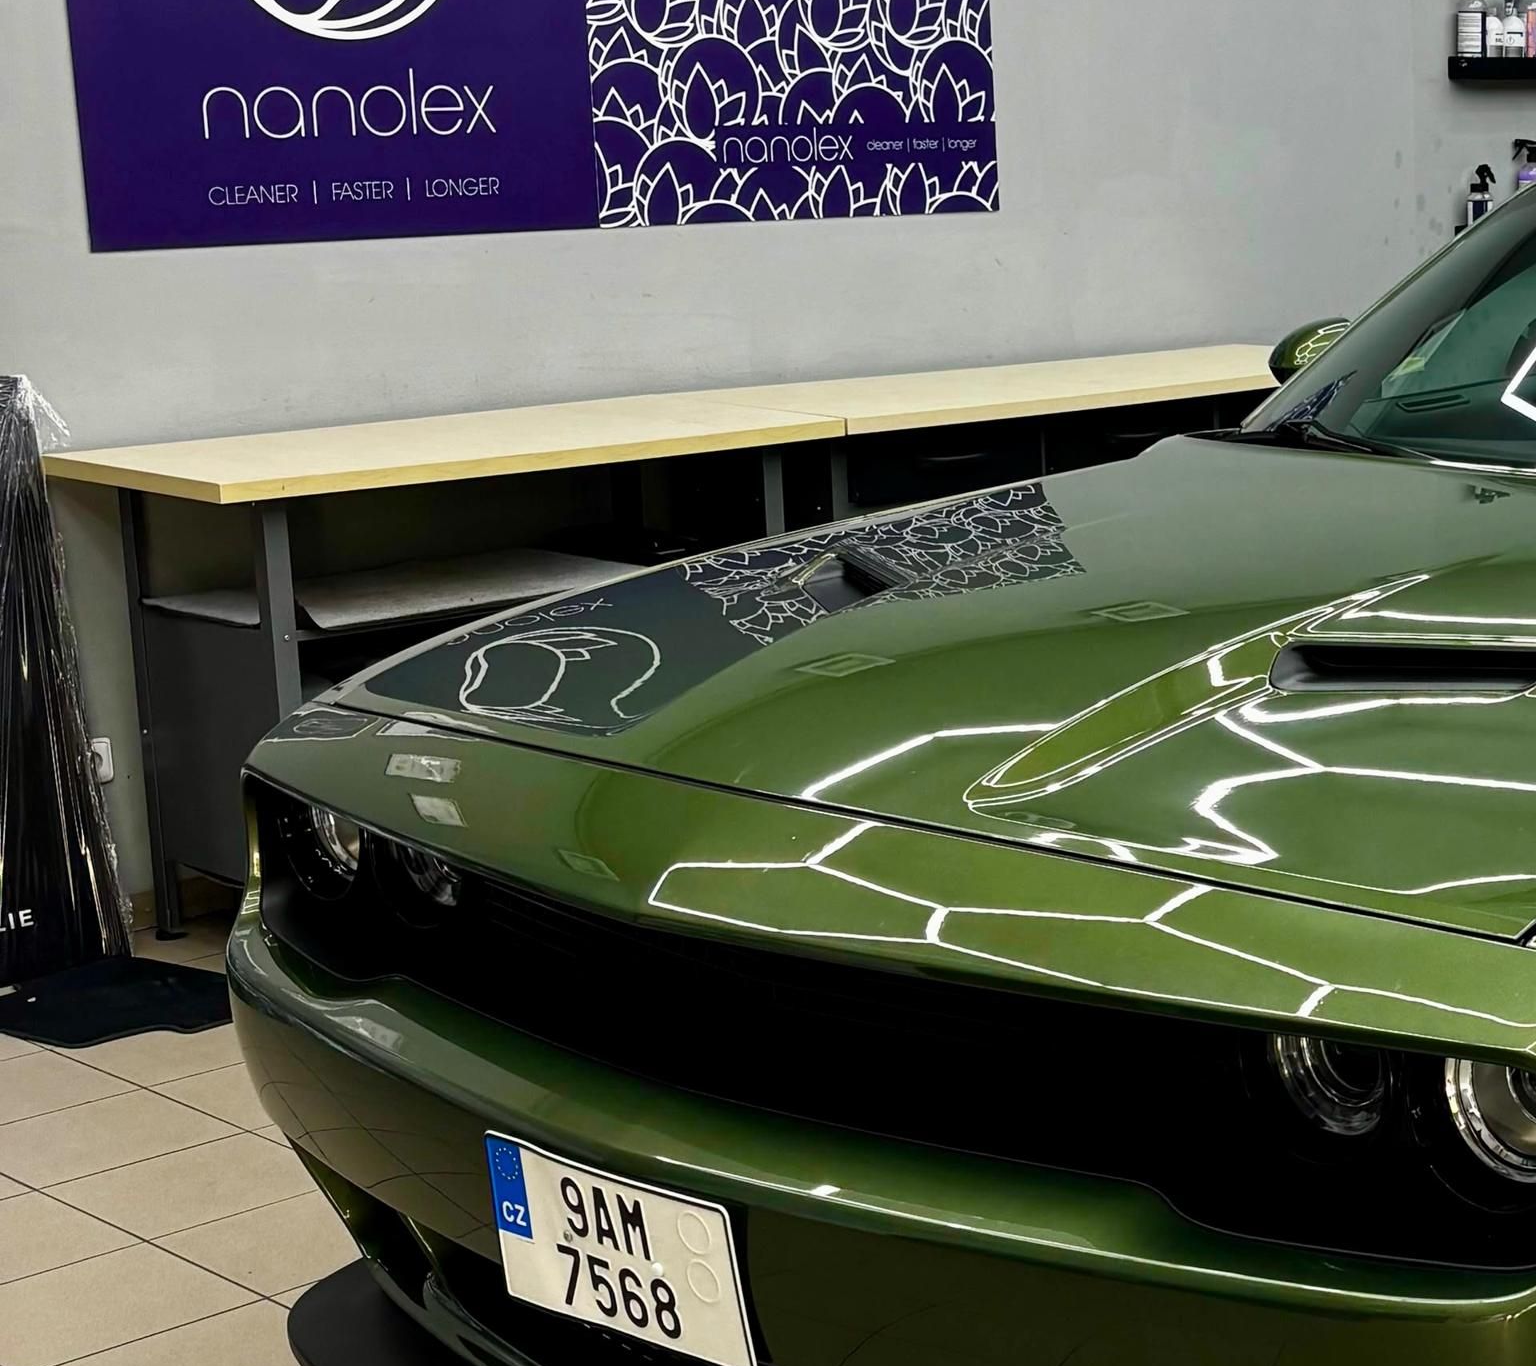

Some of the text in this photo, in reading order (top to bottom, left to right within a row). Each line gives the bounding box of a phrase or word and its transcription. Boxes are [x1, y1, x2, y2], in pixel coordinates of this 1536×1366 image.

[202, 68, 498, 140] nanolex
[722, 126, 978, 164] nanolex cleaner faster longer
[207, 177, 500, 208] CLEANER FASTER LONGER
[502, 1200, 528, 1227] CZ
[560, 1176, 652, 1261] 9AM
[556, 1243, 683, 1340] 7568
